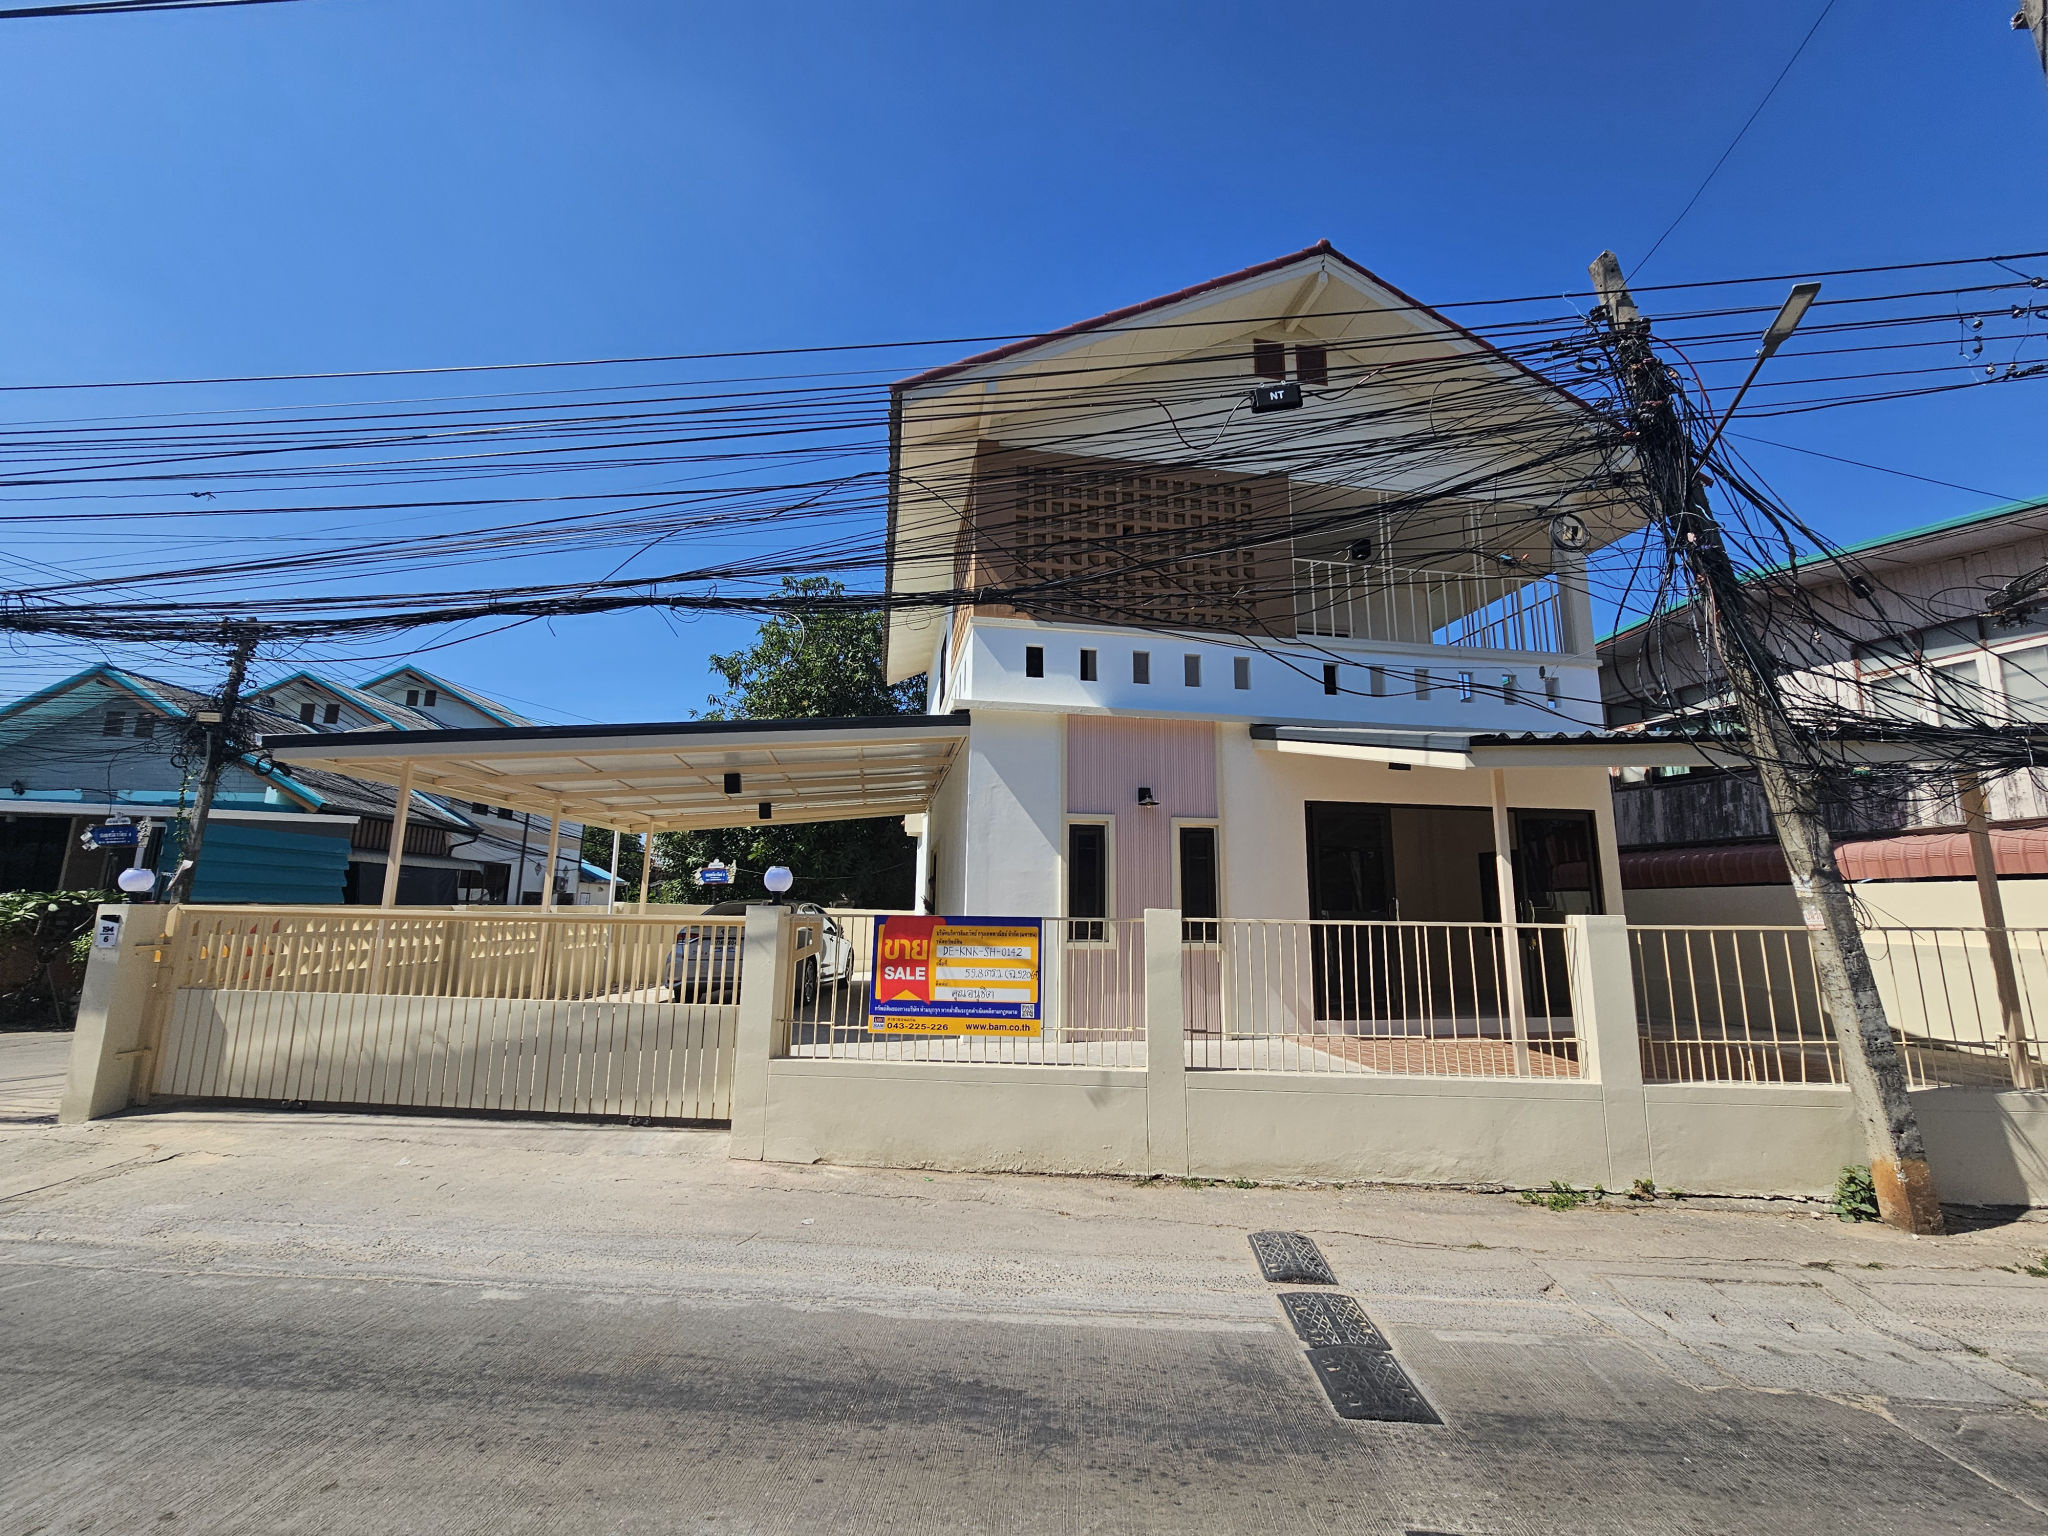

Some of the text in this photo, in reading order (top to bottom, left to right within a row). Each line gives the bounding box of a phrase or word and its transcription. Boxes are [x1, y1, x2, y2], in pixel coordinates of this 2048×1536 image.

[1270, 391, 1284, 400] NT
[884, 938, 928, 960] ขาย
[884, 966, 926, 980] SALE
[887, 1022, 1031, 1031] 043-225-226 www.bam.co.th
